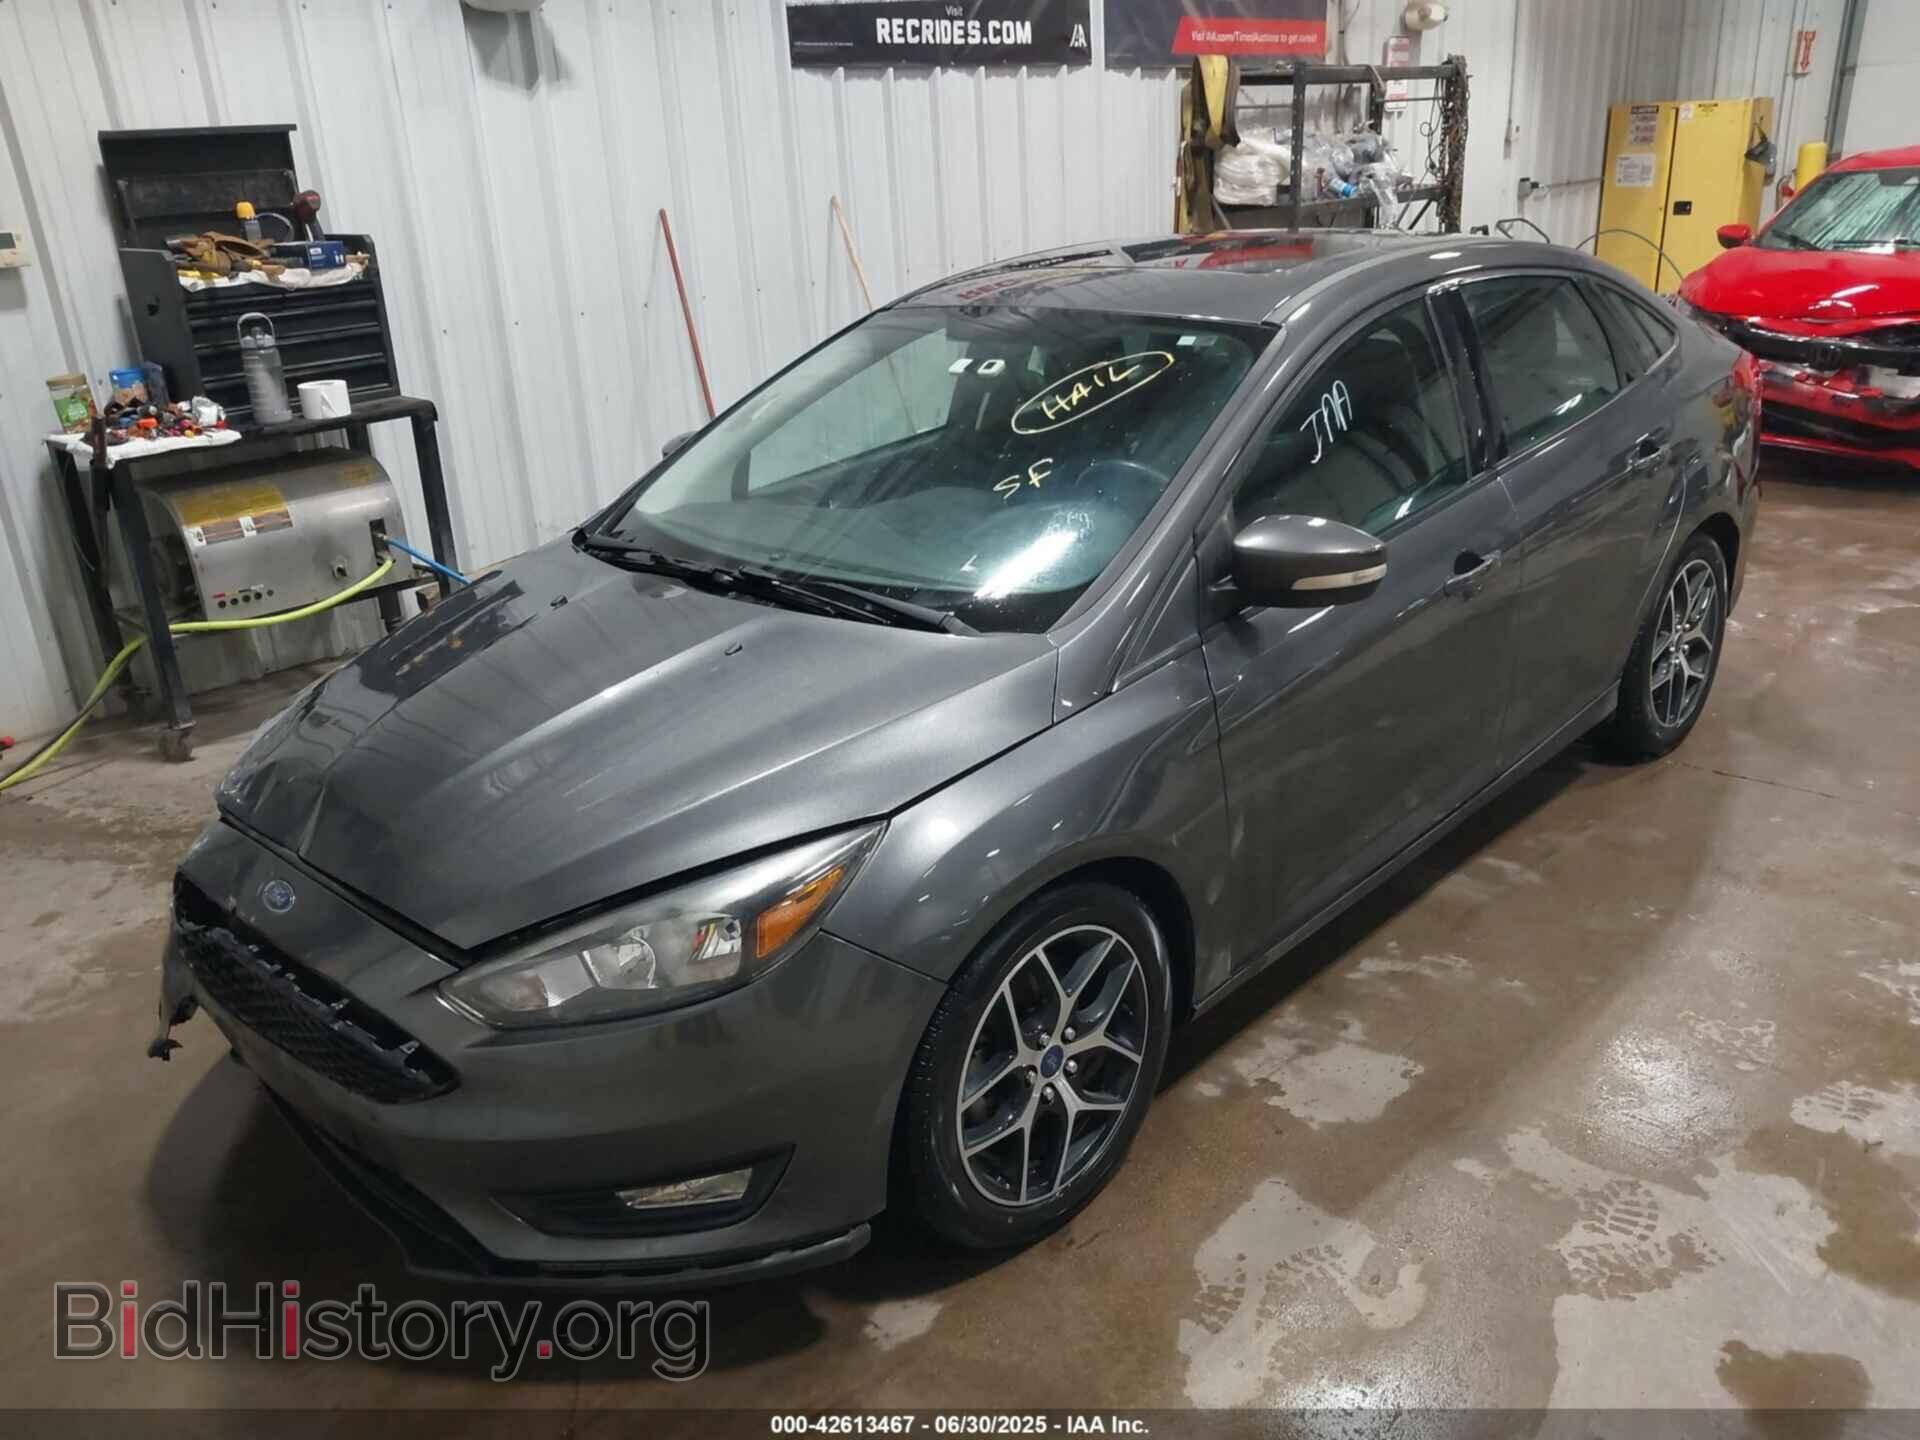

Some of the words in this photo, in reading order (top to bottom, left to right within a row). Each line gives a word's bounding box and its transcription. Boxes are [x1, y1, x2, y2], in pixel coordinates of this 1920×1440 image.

[944, 4, 964, 17] Visit
[875, 17, 1032, 46] RECRIDES.COM
[1040, 364, 1141, 420] HAIL
